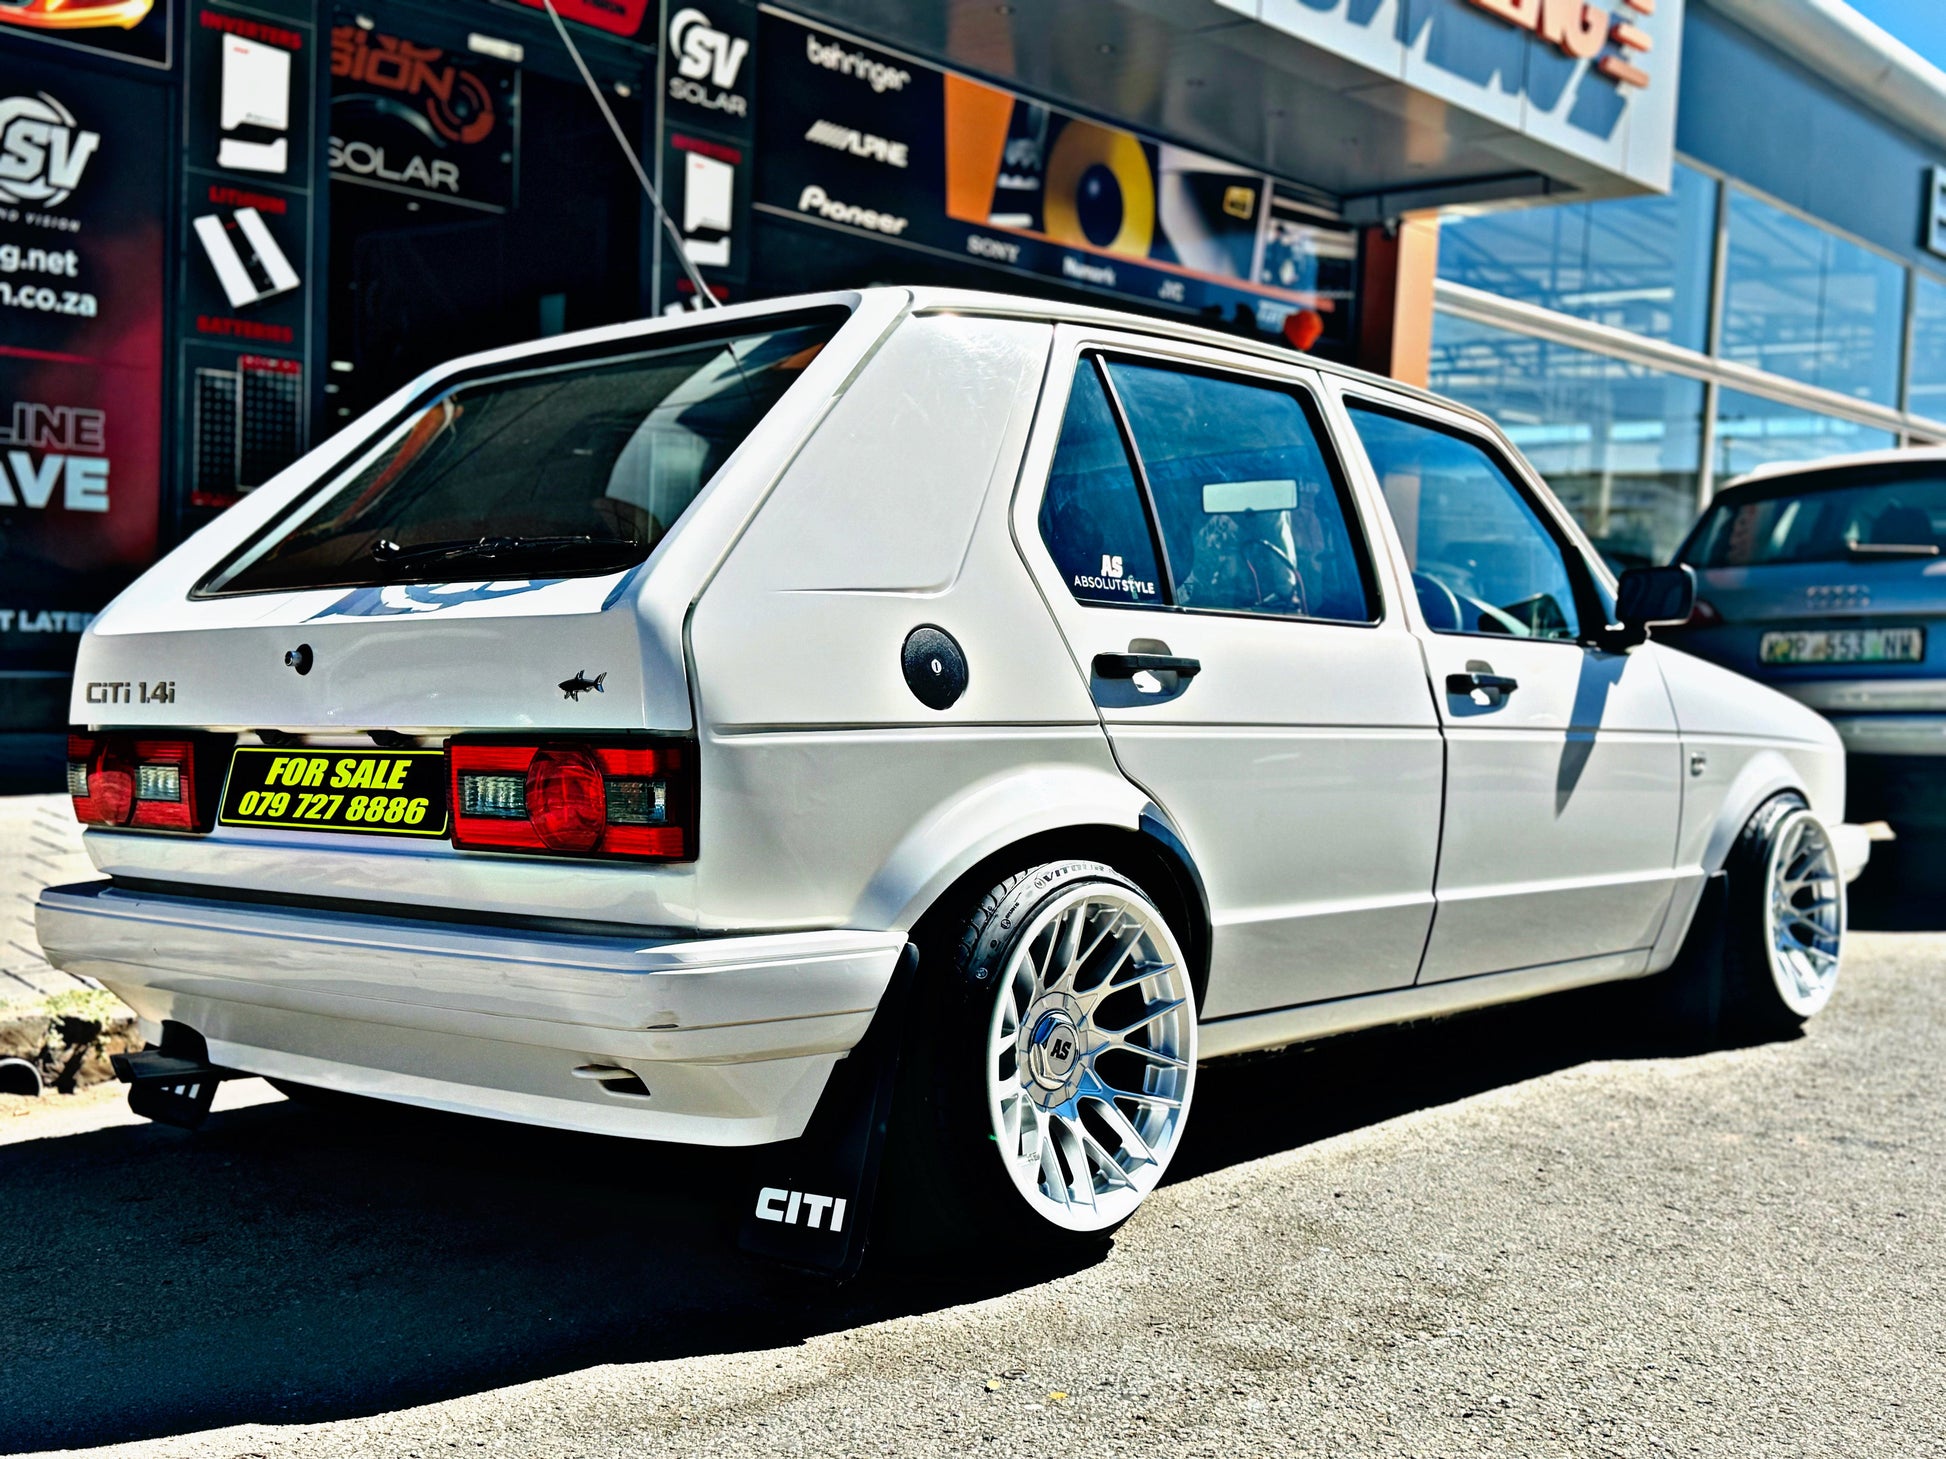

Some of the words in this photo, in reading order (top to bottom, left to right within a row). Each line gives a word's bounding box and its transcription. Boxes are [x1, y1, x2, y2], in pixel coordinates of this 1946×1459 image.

[680, 26, 749, 88] SV
[806, 34, 911, 93] behringer
[669, 77, 747, 118] SOLAR
[0, 119, 100, 190] SV
[328, 135, 459, 193] SOLAR
[798, 185, 908, 235] Pioneer
[967, 234, 1021, 263] SONY
[1074, 574, 1156, 595] ABSOLUTSTYLE
[1100, 554, 1123, 578] AS
[139, 681, 175, 703] 1.4i
[264, 757, 329, 786] FOR
[330, 758, 412, 789] SALE
[238, 790, 291, 817] 079
[292, 793, 344, 819] 727
[345, 795, 429, 824] 8886
[1050, 1038, 1073, 1061] AS
[755, 1187, 847, 1232] CITI
